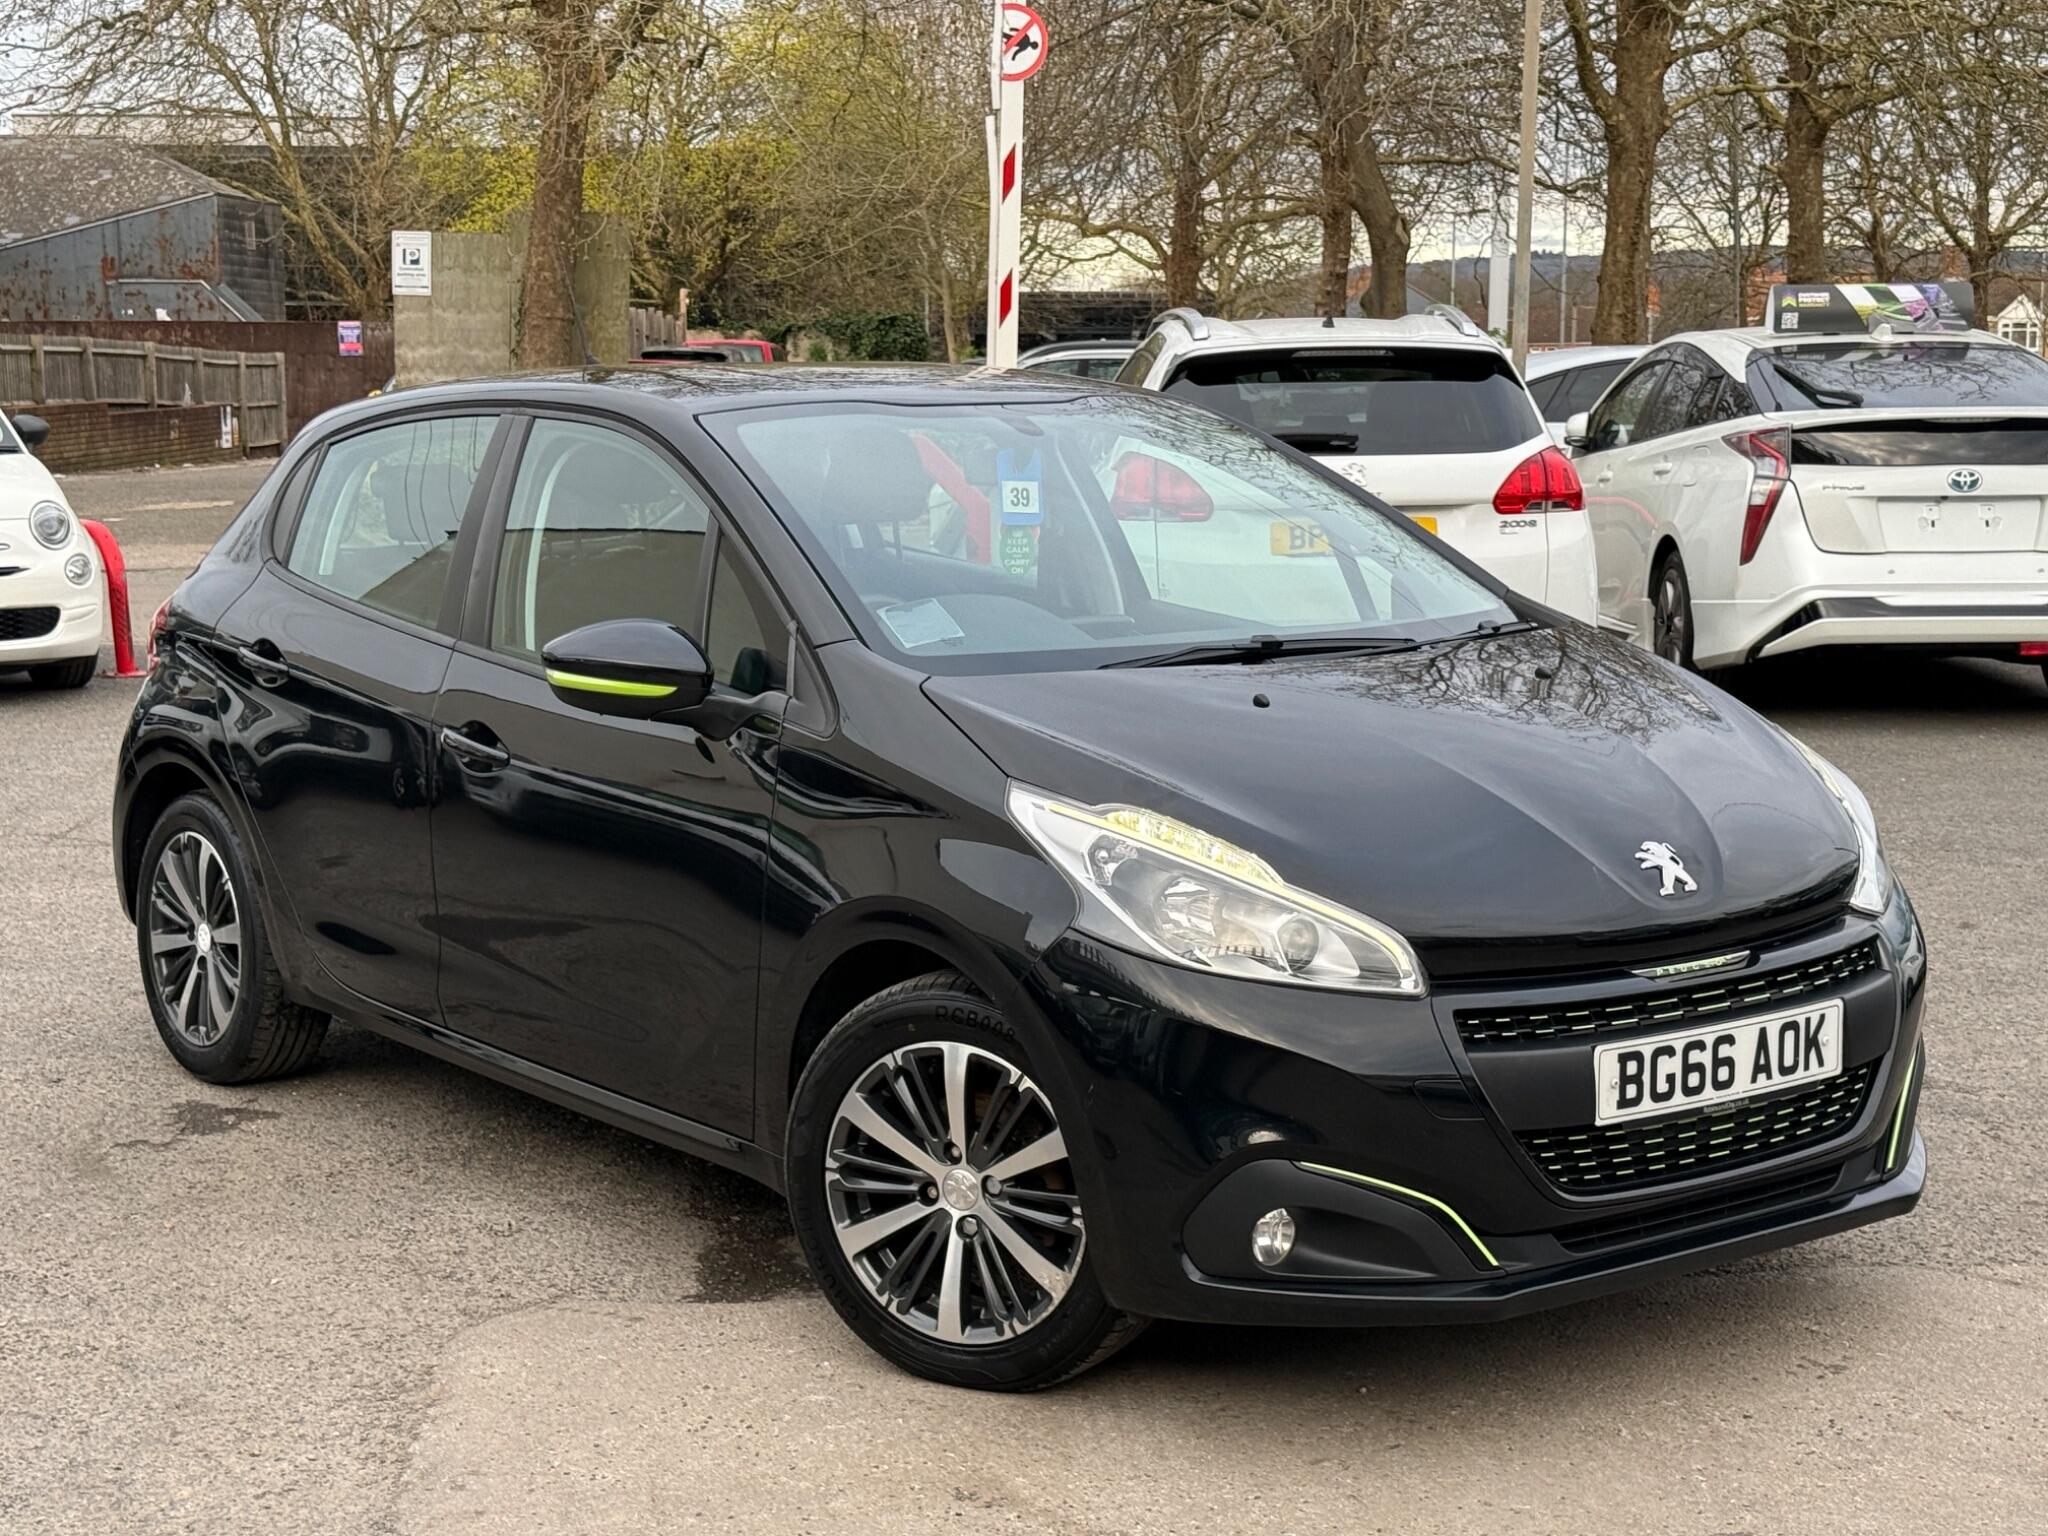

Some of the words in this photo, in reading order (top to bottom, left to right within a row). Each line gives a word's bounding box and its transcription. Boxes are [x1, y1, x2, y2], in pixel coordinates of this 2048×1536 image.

[1010, 487, 1031, 507] 39
[1499, 520, 1537, 528] 2008
[1004, 558, 1030, 566] CARRY
[1011, 566, 1024, 574] ON
[1616, 1033, 1736, 1110] BG66
[1750, 1012, 1826, 1084] AOK
